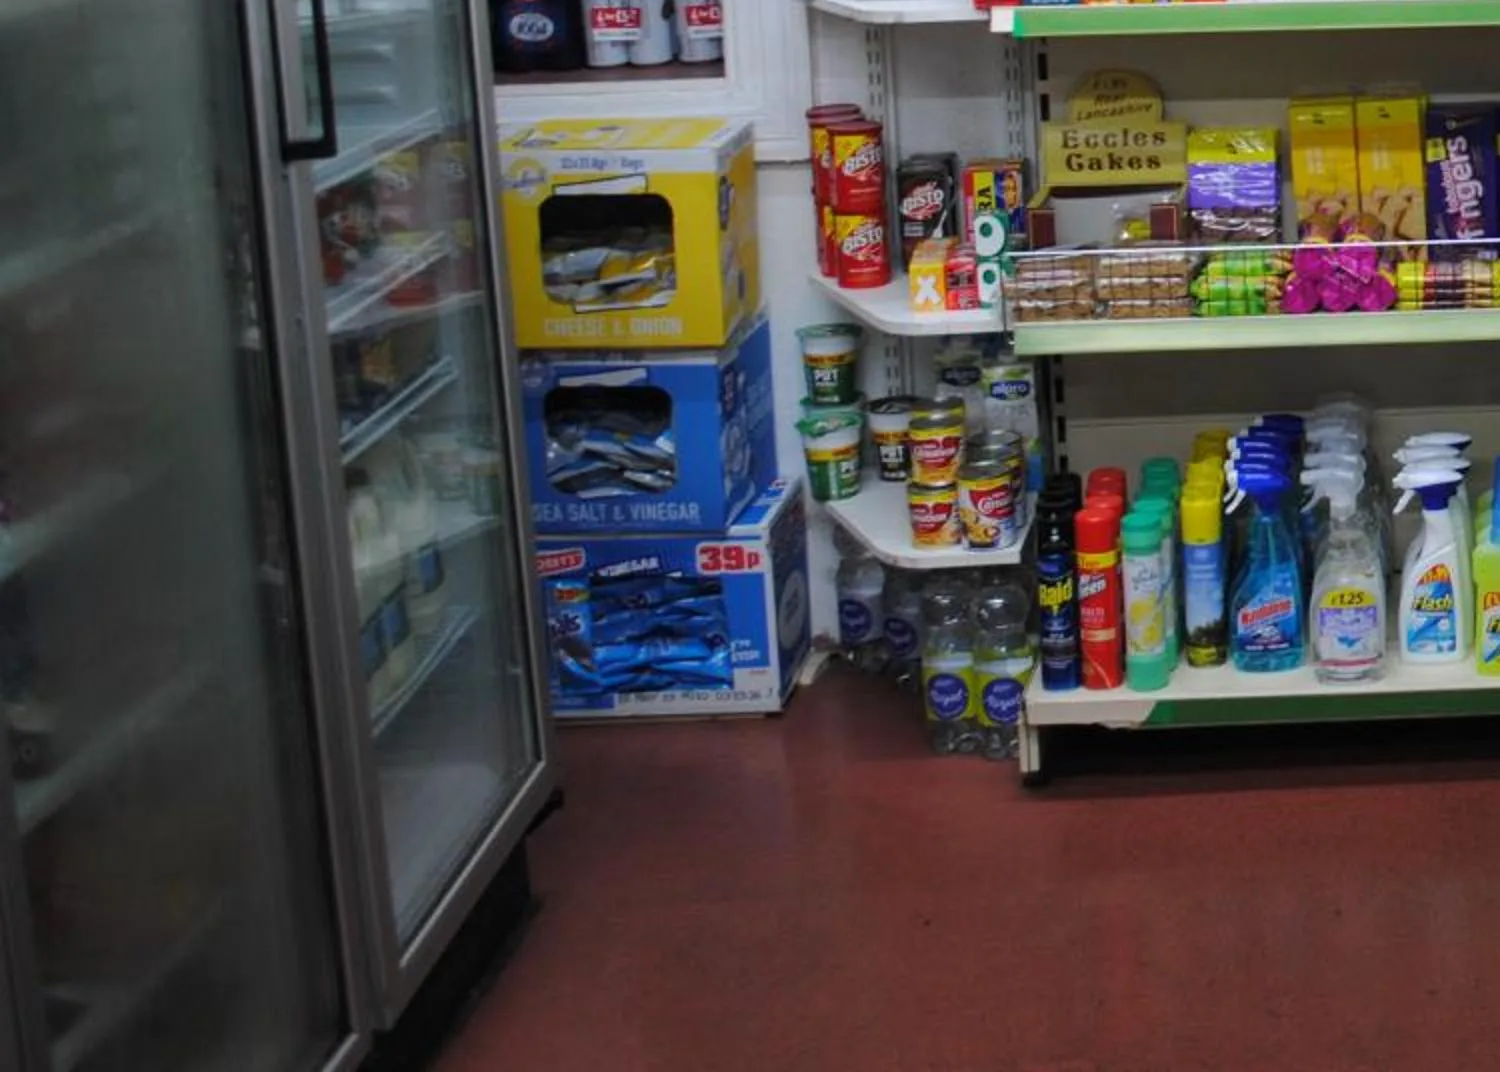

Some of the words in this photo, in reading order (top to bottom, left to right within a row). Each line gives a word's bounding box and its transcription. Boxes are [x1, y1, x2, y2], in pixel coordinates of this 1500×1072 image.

[1061, 126, 1168, 150] Eccles
[1065, 152, 1163, 173] Cakes
[991, 379, 1029, 397] alpro
[533, 502, 564, 523] SEA
[567, 503, 606, 522] SALT
[612, 503, 624, 521] &
[630, 501, 700, 522] VINEGAR
[698, 545, 764, 571] 39p
[1412, 595, 1455, 613] Flash
